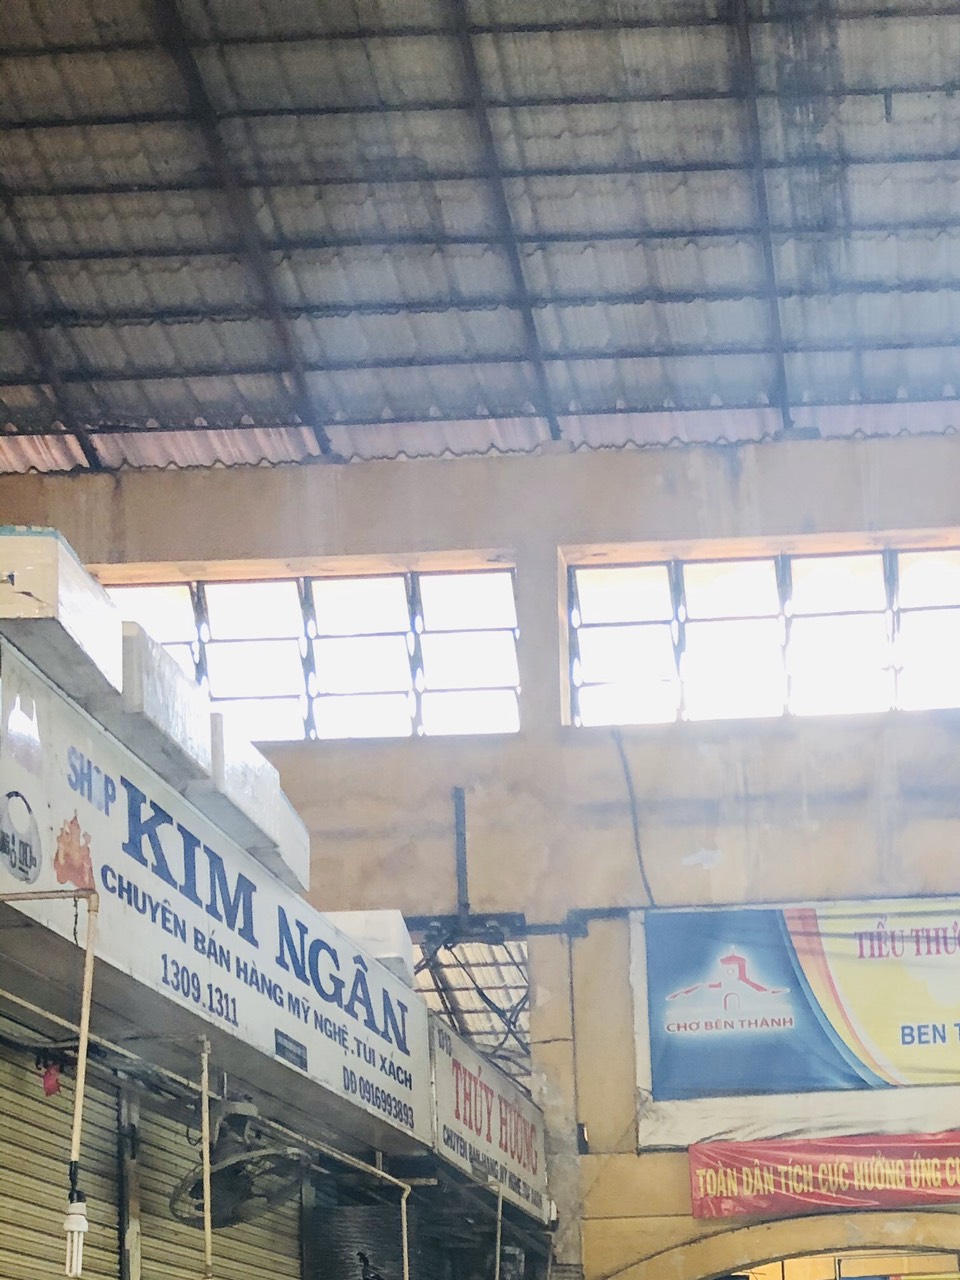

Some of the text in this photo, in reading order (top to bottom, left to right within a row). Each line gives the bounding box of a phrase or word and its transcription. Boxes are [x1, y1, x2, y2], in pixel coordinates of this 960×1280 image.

[120, 775, 411, 1057] KIM NGÂN
[853, 916, 906, 960] TIỂU
[101, 864, 187, 944] CHUYÊN
[193, 926, 231, 973] BÁN
[236, 957, 284, 1009] HÀNG
[287, 991, 311, 1025] MỸ
[313, 1009, 349, 1057] NGHỆ
[379, 1051, 413, 1091] XÁCH
[161, 953, 239, 1028] 1309.1311
[900, 1023, 947, 1046] BEN
[695, 1160, 739, 1199] TOÀN
[742, 1158, 775, 1196] DÂN
[777, 1157, 814, 1194] TÍCH
[818, 1158, 849, 1198] CỰC
[853, 1150, 906, 1191] HƯỞNG
[909, 1150, 942, 1189] ỨNG
